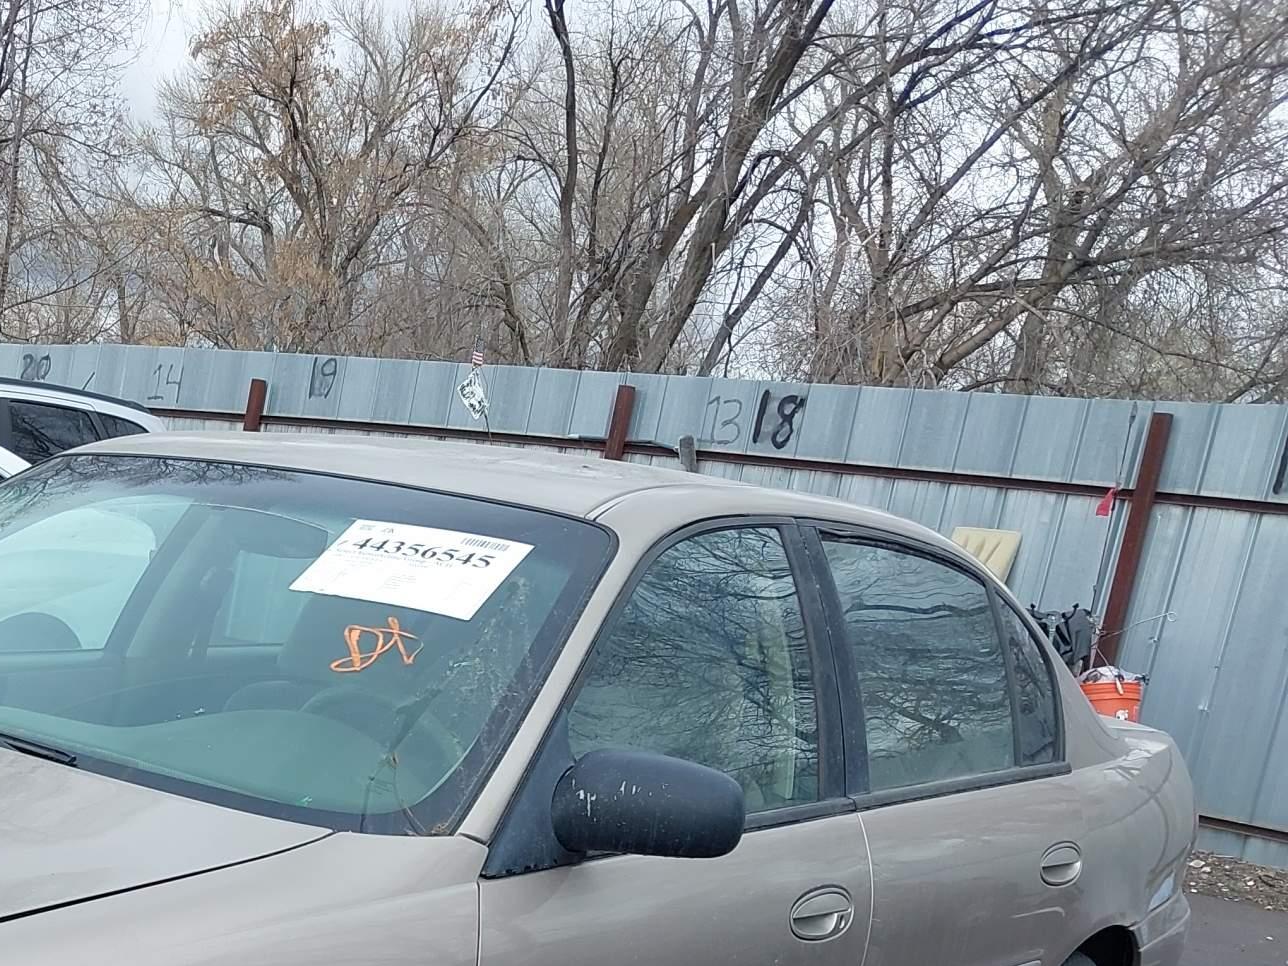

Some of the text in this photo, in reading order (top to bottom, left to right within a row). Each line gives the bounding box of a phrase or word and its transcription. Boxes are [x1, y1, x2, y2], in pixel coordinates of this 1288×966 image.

[20, 353, 52, 382] 20
[147, 363, 185, 404] 14
[308, 357, 338, 400] 19
[698, 395, 743, 445] 13
[752, 388, 806, 450] 18
[352, 537, 497, 569] 44356545
